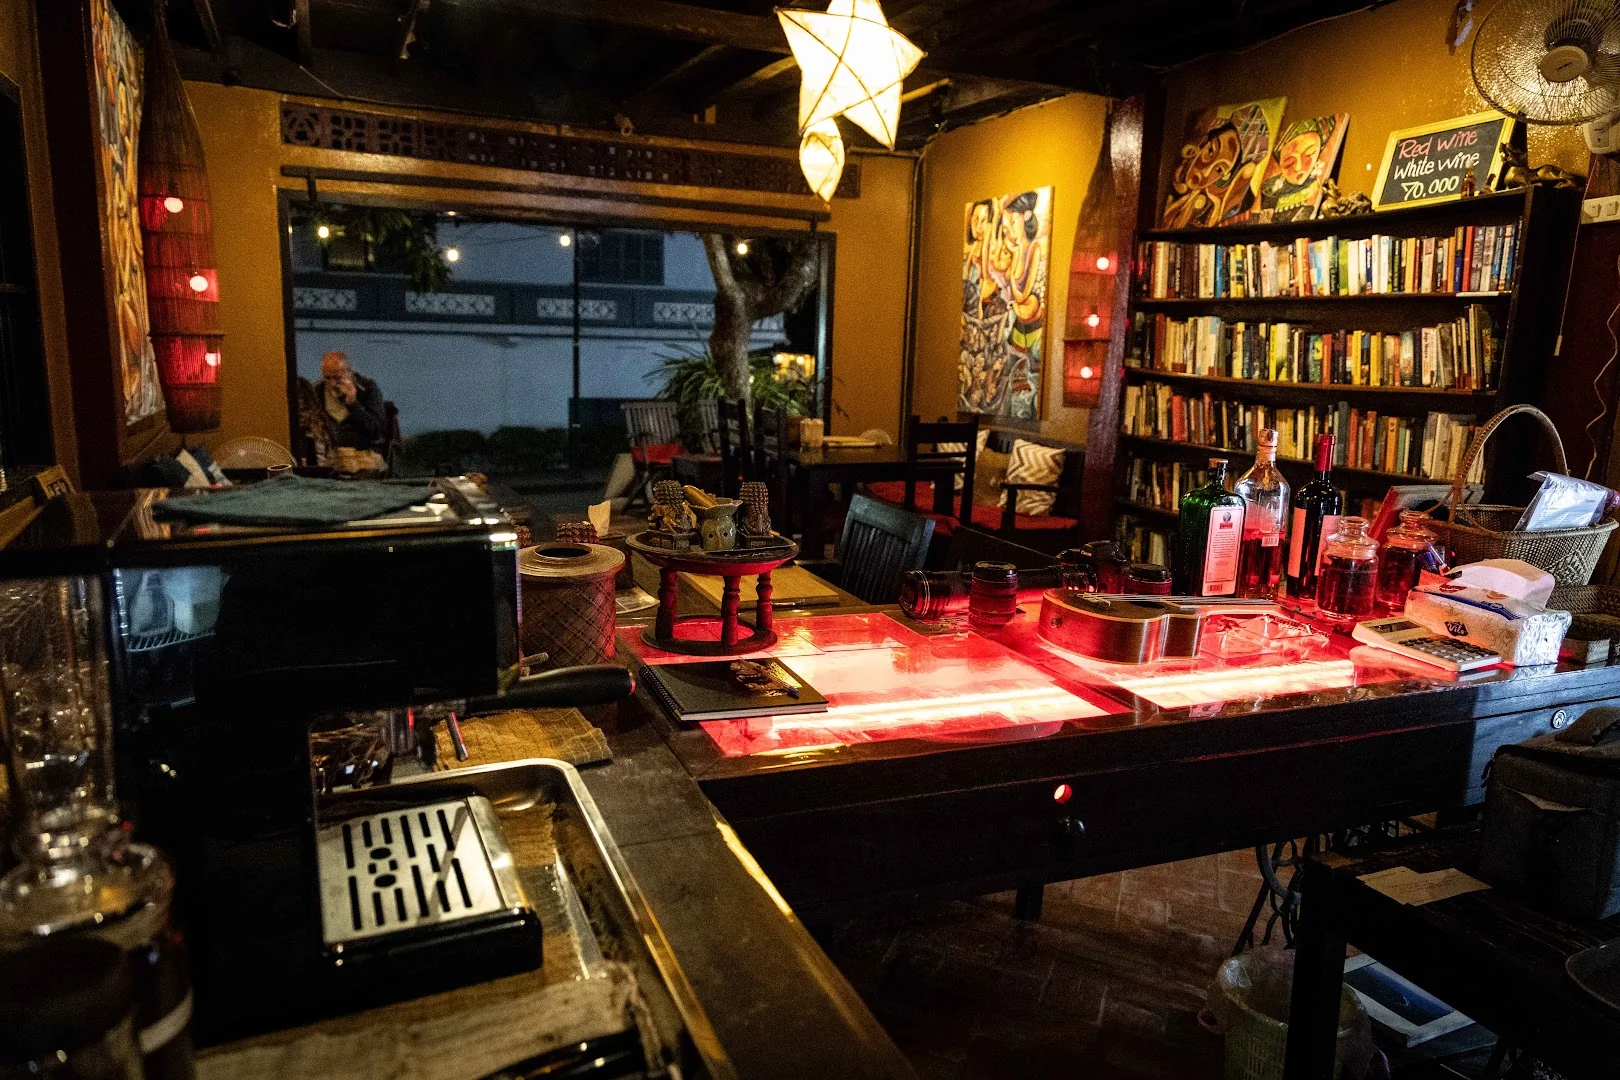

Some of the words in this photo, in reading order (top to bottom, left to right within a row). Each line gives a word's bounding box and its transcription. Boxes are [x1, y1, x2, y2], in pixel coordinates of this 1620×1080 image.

[1398, 137, 1433, 159] Red
[1437, 129, 1478, 152] wine
[1438, 152, 1480, 171] wine
[1400, 175, 1460, 201] 70.000
